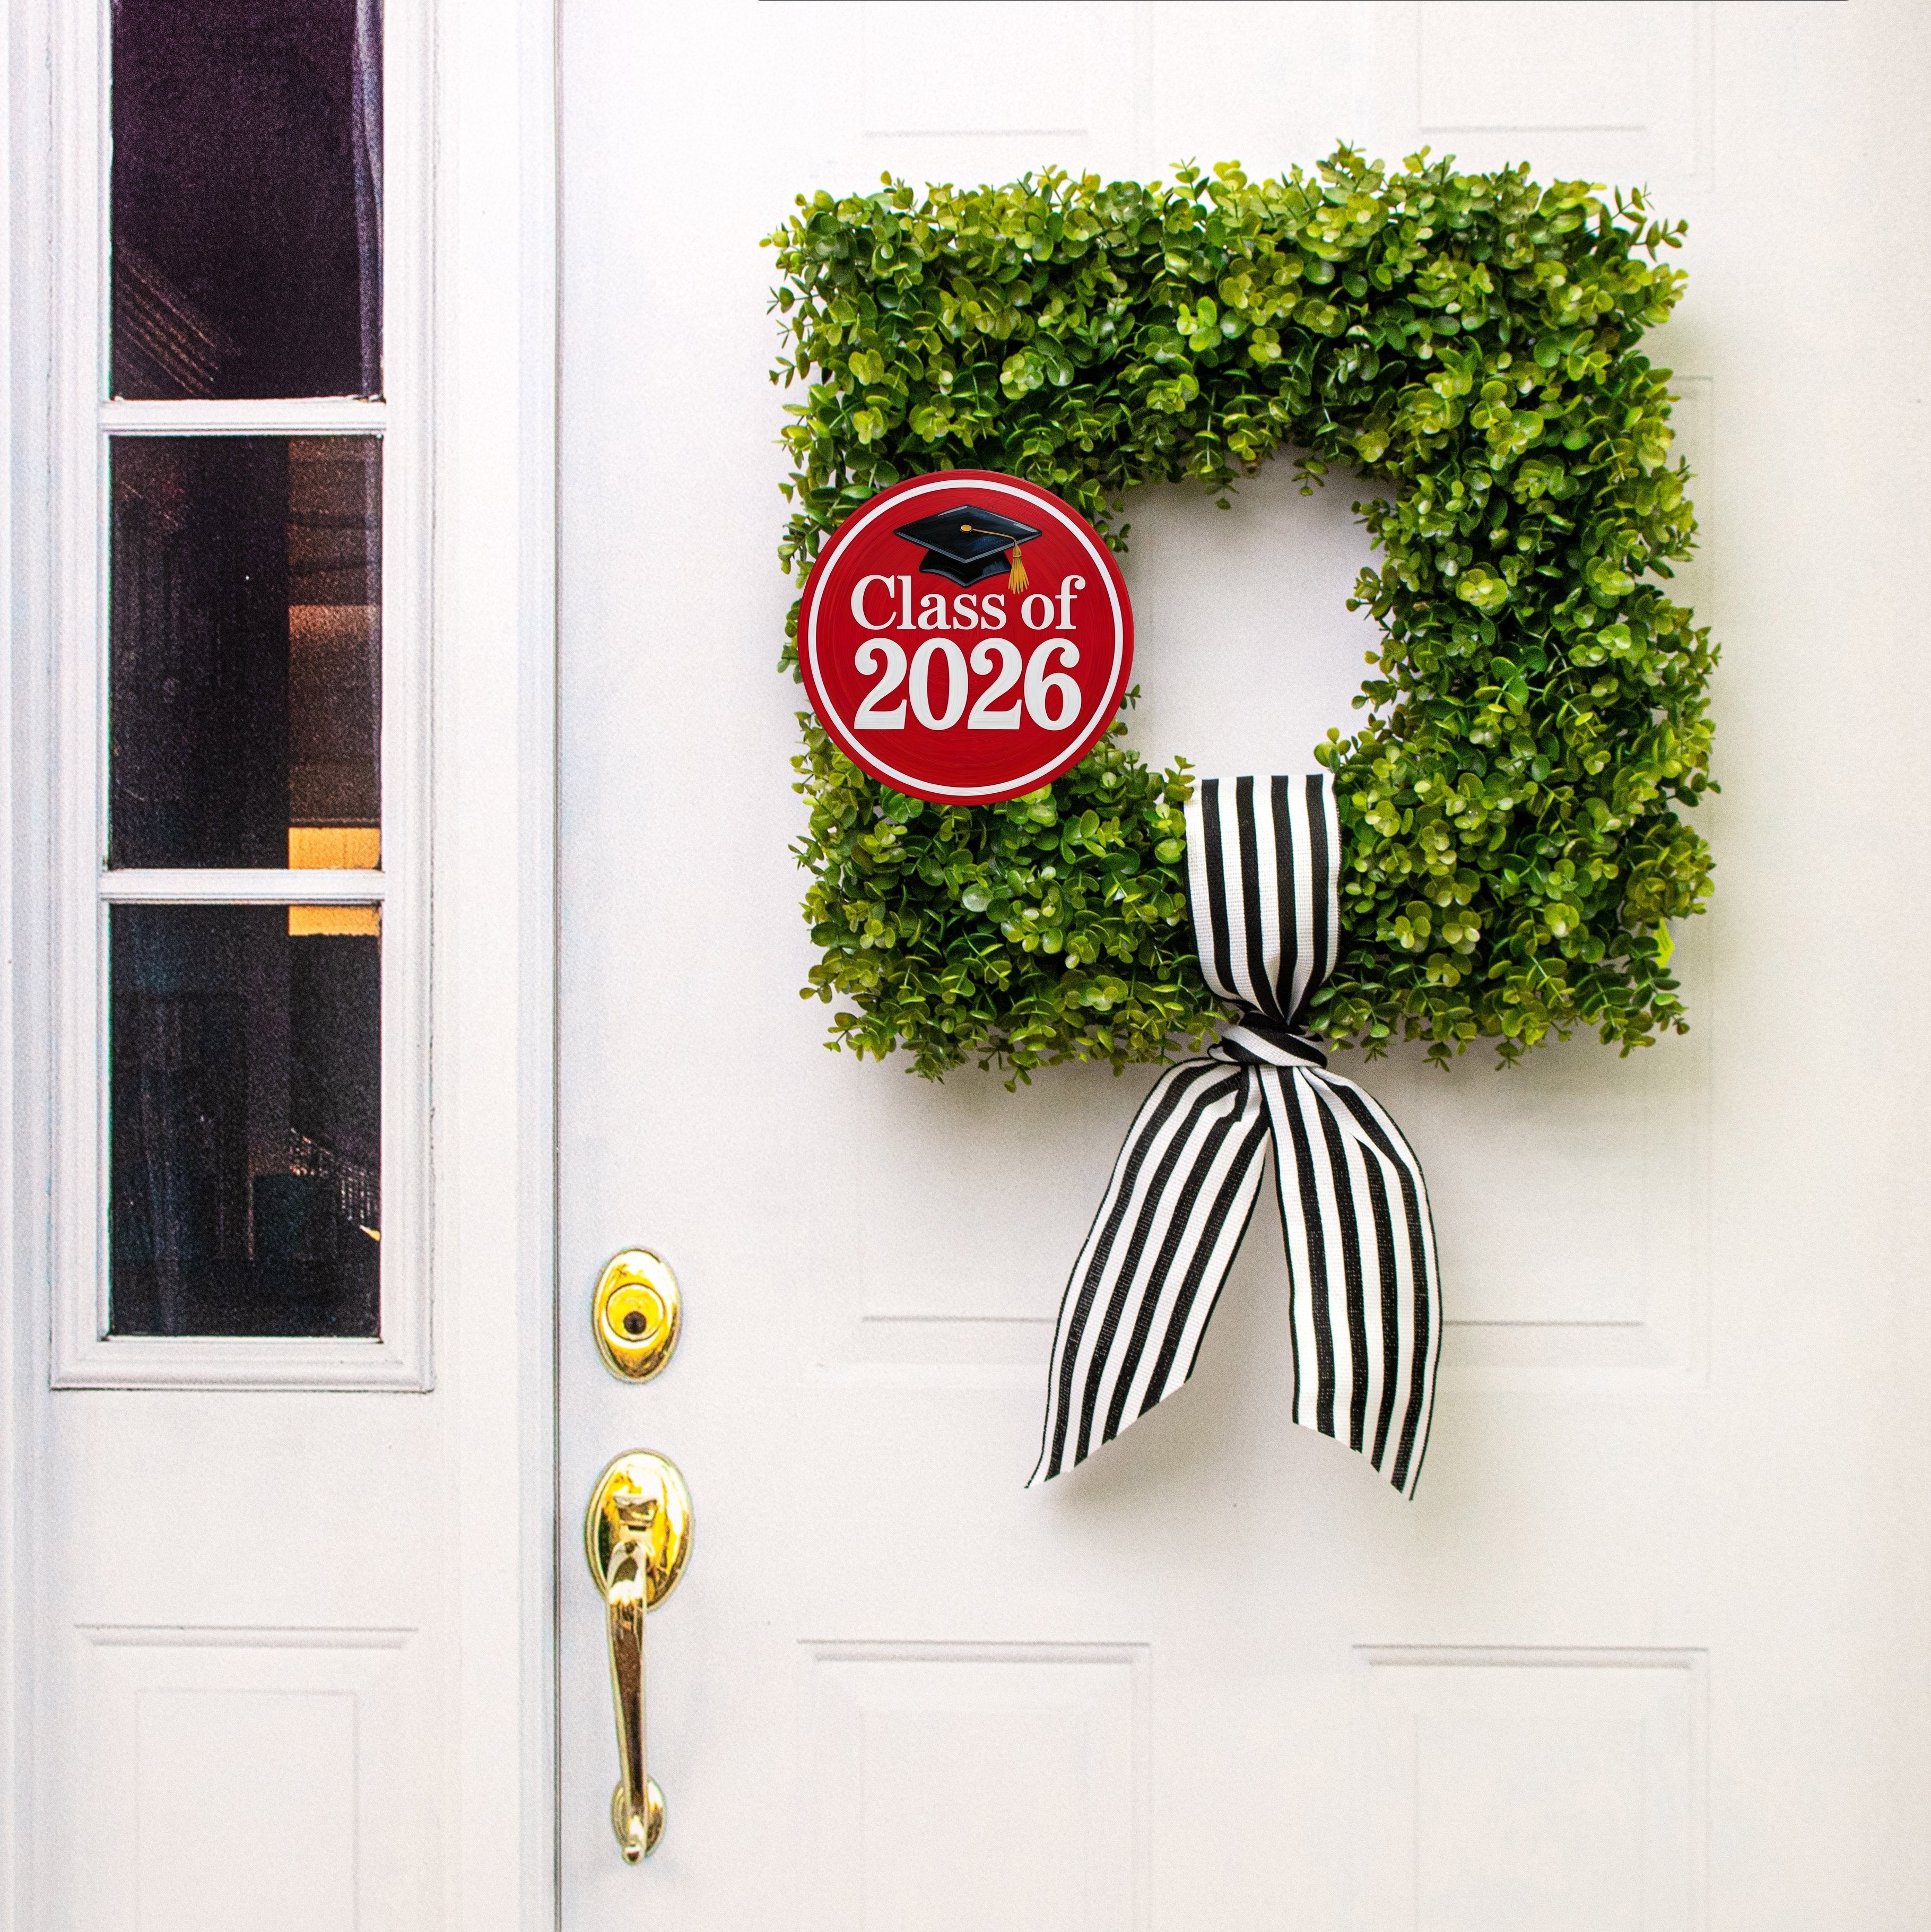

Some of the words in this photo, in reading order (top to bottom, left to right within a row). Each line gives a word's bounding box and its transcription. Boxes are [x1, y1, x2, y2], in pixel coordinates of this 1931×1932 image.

[850, 574, 1007, 630] Class
[1021, 575, 1086, 630] of
[854, 637, 1082, 731] 2026
